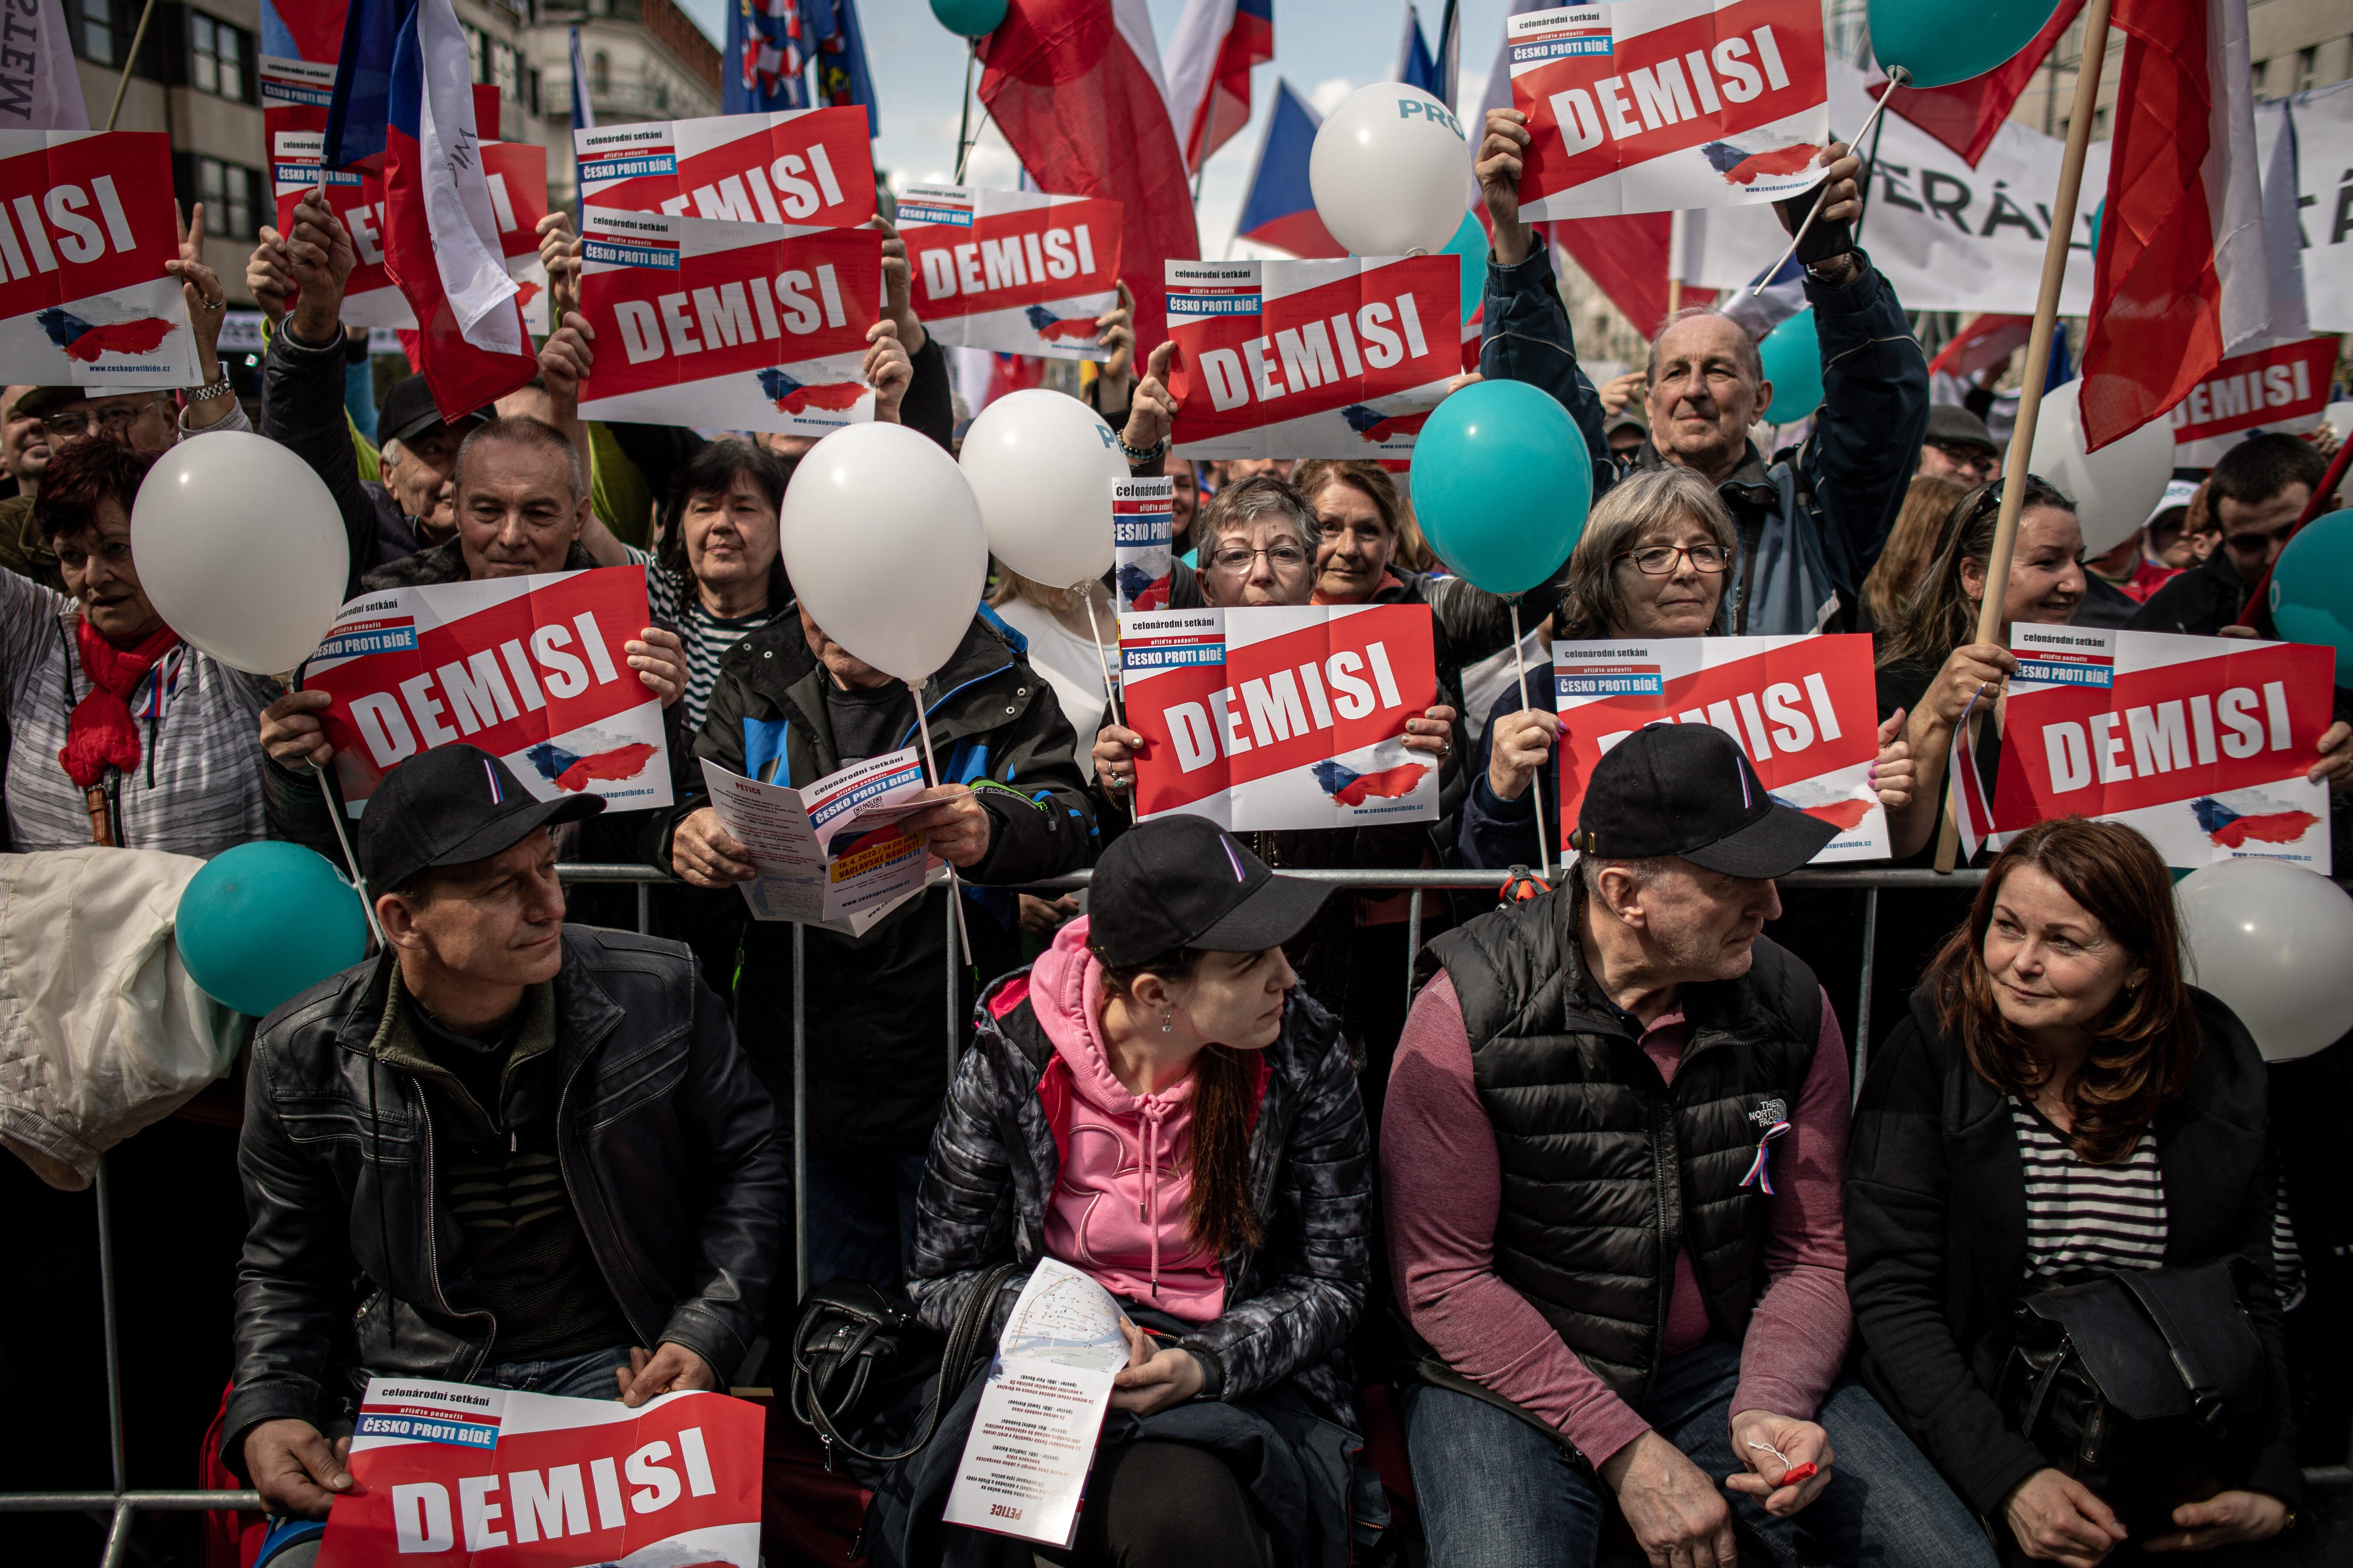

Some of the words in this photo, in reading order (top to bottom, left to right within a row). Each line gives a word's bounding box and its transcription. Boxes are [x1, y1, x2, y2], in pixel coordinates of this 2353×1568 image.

[1519, 15, 1567, 29] celonárodní
[1569, 13, 1599, 22] setkání
[1514, 45, 1548, 60] ČESKO
[1550, 42, 1582, 55] PROTI
[1584, 39, 1608, 52] BÍDĚ
[265, 84, 289, 99] ČESKO
[291, 90, 315, 103] PROTI
[1549, 25, 1791, 157] DEMISI
[586, 132, 632, 146] celonárodní
[633, 130, 662, 141] setkání
[278, 166, 305, 180] ČESKO
[584, 163, 615, 179] ČESKO
[617, 162, 647, 175] PROTI
[649, 158, 673, 172] BÍDĚ
[899, 207, 925, 219] ČESKO
[926, 211, 950, 222] PROTI
[593, 217, 637, 229] celonárodní
[639, 221, 668, 232] setkání
[586, 243, 616, 261] ČESKO
[618, 249, 648, 264] PROTI
[651, 250, 675, 266] BÍDĚ
[920, 224, 1096, 301] DEMISI
[1221, 270, 1251, 278] setkání
[1170, 297, 1200, 311] ČESKO
[1202, 300, 1232, 311] PROTI
[1234, 297, 1258, 311] BÍDĚ
[613, 264, 846, 365] DEMISI
[1198, 292, 1428, 412] DEMISI
[1116, 483, 1166, 497] celonárodní
[1140, 503, 1157, 512] přijďte
[366, 599, 398, 612] setkání
[354, 622, 381, 631] podpořit
[1132, 619, 1183, 630] celonárodní
[1184, 618, 1214, 628] setkání
[345, 636, 381, 652] PROTI
[382, 630, 412, 648] BÍDĚ
[2024, 634, 2073, 645] celonárodní
[2075, 638, 2105, 647] setkání
[1127, 651, 1162, 666] ČESKO
[1165, 650, 1197, 664] PROTI
[1198, 647, 1222, 661] BÍDĚ
[1564, 649, 1615, 658] celonárodní
[1617, 649, 1648, 657] setkání
[2051, 667, 2083, 682] PROTI
[2085, 669, 2109, 684] BÍDĚ
[349, 611, 619, 768] DEMISI
[1560, 679, 1596, 692] ČESKO
[1598, 680, 1631, 691] PROTI
[1632, 677, 1658, 691] BÍDĚ
[1163, 641, 1402, 774] DEMISI
[2042, 681, 2292, 794] DEMISI
[814, 766, 867, 796] celonárodní
[870, 756, 904, 771] setkání
[735, 782, 762, 796] PETICE
[815, 797, 852, 824] ČESKO
[853, 781, 887, 805] PROTI
[889, 770, 916, 786] BÍDĚ
[1353, 804, 1423, 814] www.ceskoprotibide.cz
[839, 855, 884, 878] VÁCLAVSKÉ
[885, 839, 919, 858] NÁMĚSTÍ
[858, 850, 876, 862] 2023
[884, 840, 902, 851] 14.00
[842, 879, 911, 907] www.ceskoprotibide.cz
[1760, 1099, 1777, 1109] THE
[1749, 1108, 1777, 1121] NORTH
[1758, 1115, 1777, 1127] FACE
[382, 1388, 449, 1401] celonárodní
[449, 1393, 490, 1406] setkání
[430, 1410, 463, 1420] podpořit
[363, 1417, 410, 1434] ČESKO
[412, 1422, 456, 1440] PROTI
[458, 1427, 492, 1445] BÍDĚ
[392, 1427, 716, 1554] DEMISI
[990, 1504, 1022, 1520] PETICE
